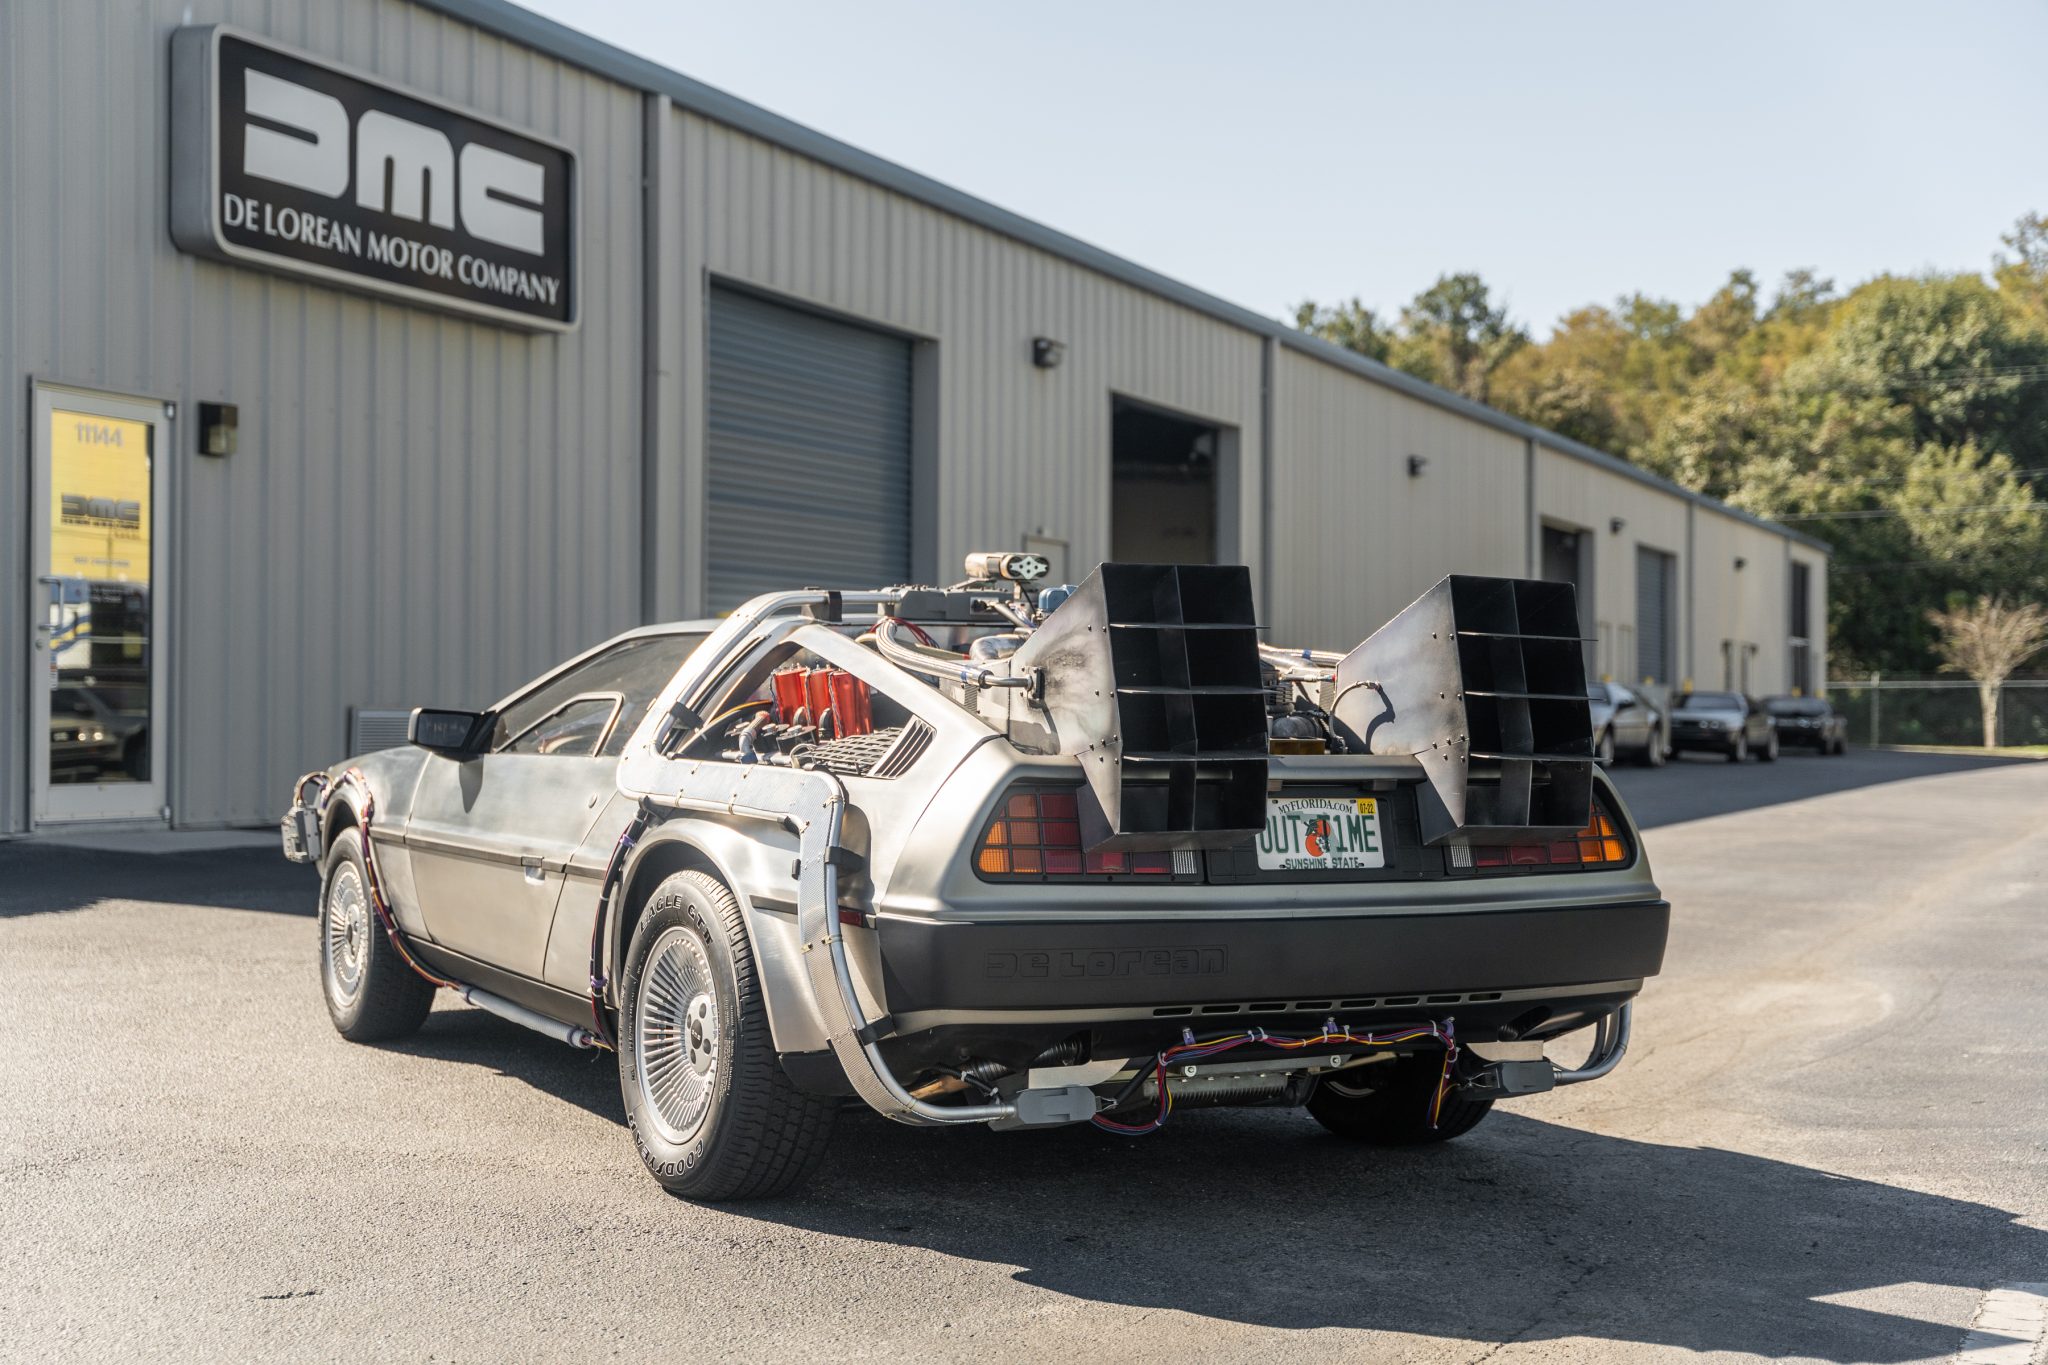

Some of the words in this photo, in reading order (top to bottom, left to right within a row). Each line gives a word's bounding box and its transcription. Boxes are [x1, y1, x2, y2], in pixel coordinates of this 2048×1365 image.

[224, 193, 259, 232] DE
[264, 203, 362, 258] LOREAN
[367, 230, 454, 281] MOTOR
[457, 254, 560, 305] COMPANY
[75, 422, 124, 447] 11144
[1260, 815, 1300, 854] OUT
[1285, 858, 1327, 869] SUNSHINE
[1332, 857, 1359, 869] STATE
[628, 1112, 704, 1177] GOODYEAR
